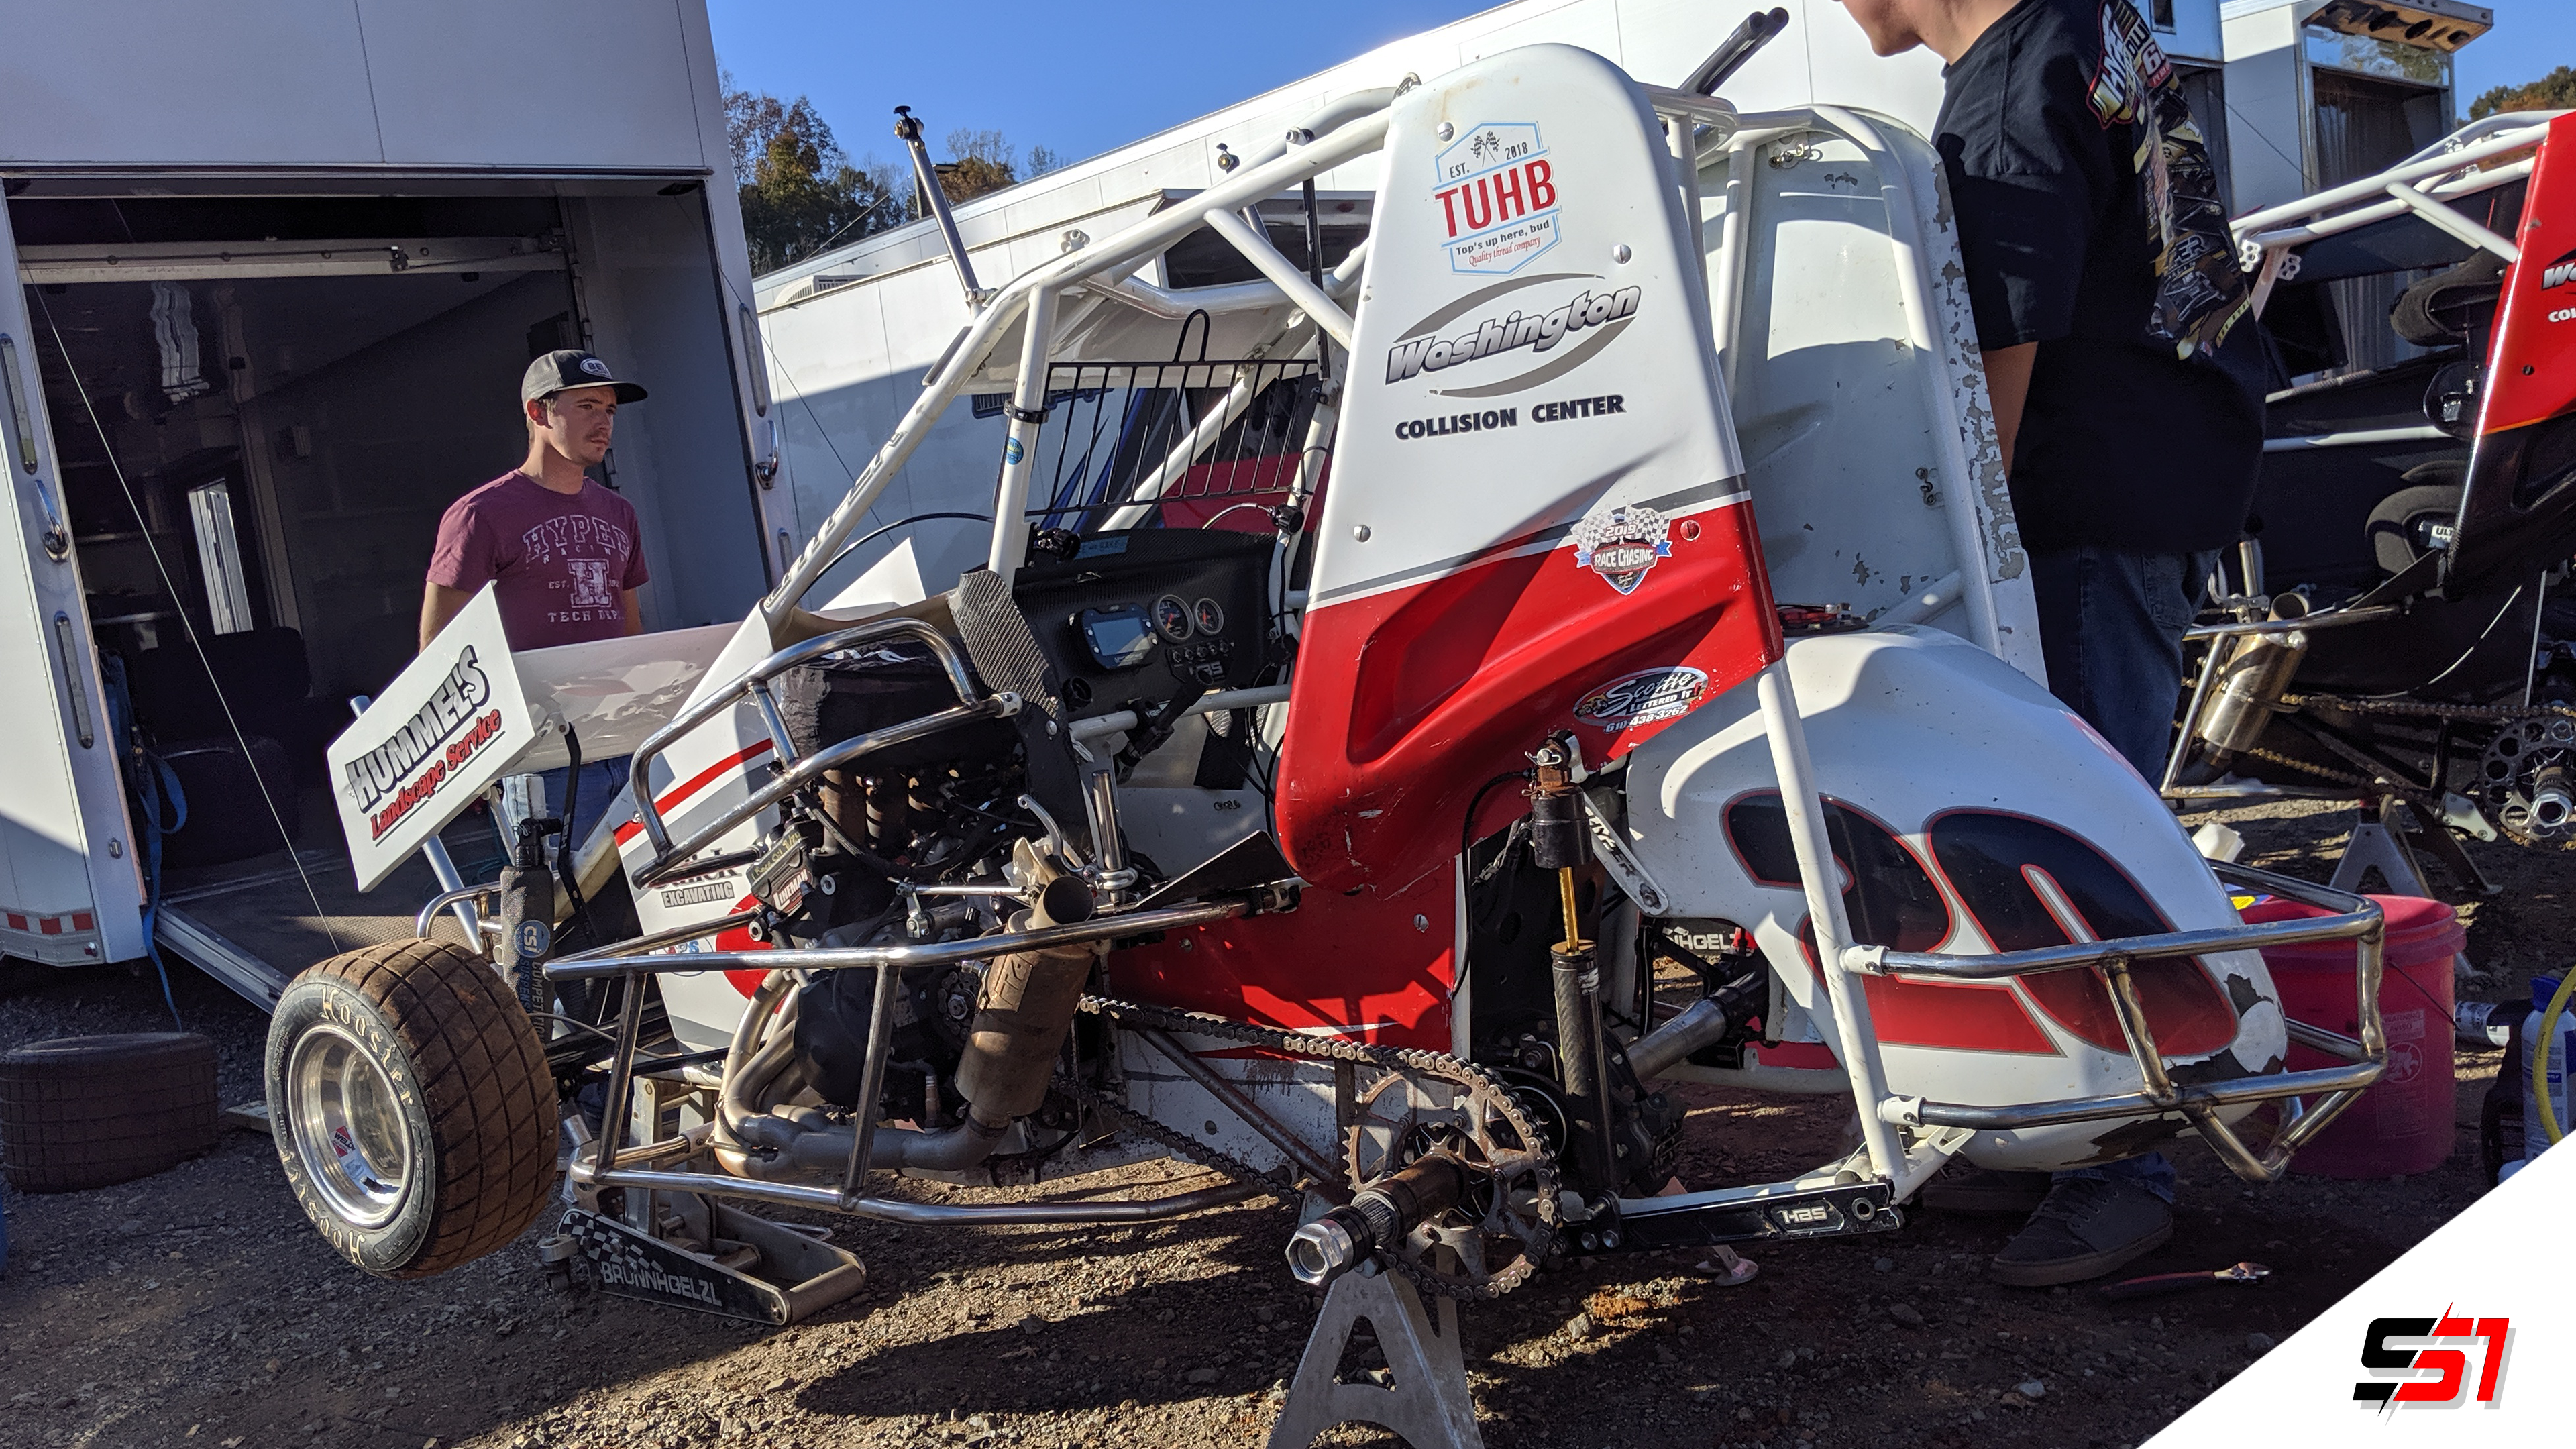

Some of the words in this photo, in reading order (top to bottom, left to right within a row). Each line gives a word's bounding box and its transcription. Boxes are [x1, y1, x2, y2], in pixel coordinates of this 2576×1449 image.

[1449, 163, 1470, 179] EST.
[1505, 142, 1528, 160] 2018
[1434, 159, 1556, 238] TUHB
[1456, 241, 1483, 256] Top's
[1485, 237, 1498, 248] up
[1500, 229, 1528, 243] here,
[1530, 219, 1550, 233] bud
[1469, 251, 1493, 268] Quality
[1493, 244, 1513, 258] thread
[1514, 237, 1541, 252] company
[1385, 285, 1642, 385] Washington
[1395, 407, 1518, 440] COLLISION
[1531, 394, 1627, 423] CENTER
[1605, 523, 1638, 538] 2019
[1594, 551, 1617, 568] RACE
[1618, 548, 1654, 567] CHASING
[547, 610, 591, 623] TECH
[1593, 672, 1695, 718] Scottie
[345, 645, 490, 814] HUMMEL'S
[370, 759, 447, 841] Landscape
[445, 709, 502, 771] Service
[661, 881, 735, 908] EXCAVATING
[773, 869, 808, 911] LINEMAN
[523, 924, 537, 954] CSI
[334, 1132, 356, 1151] WELD
[600, 1261, 722, 1307] BRUNNHOELZL
